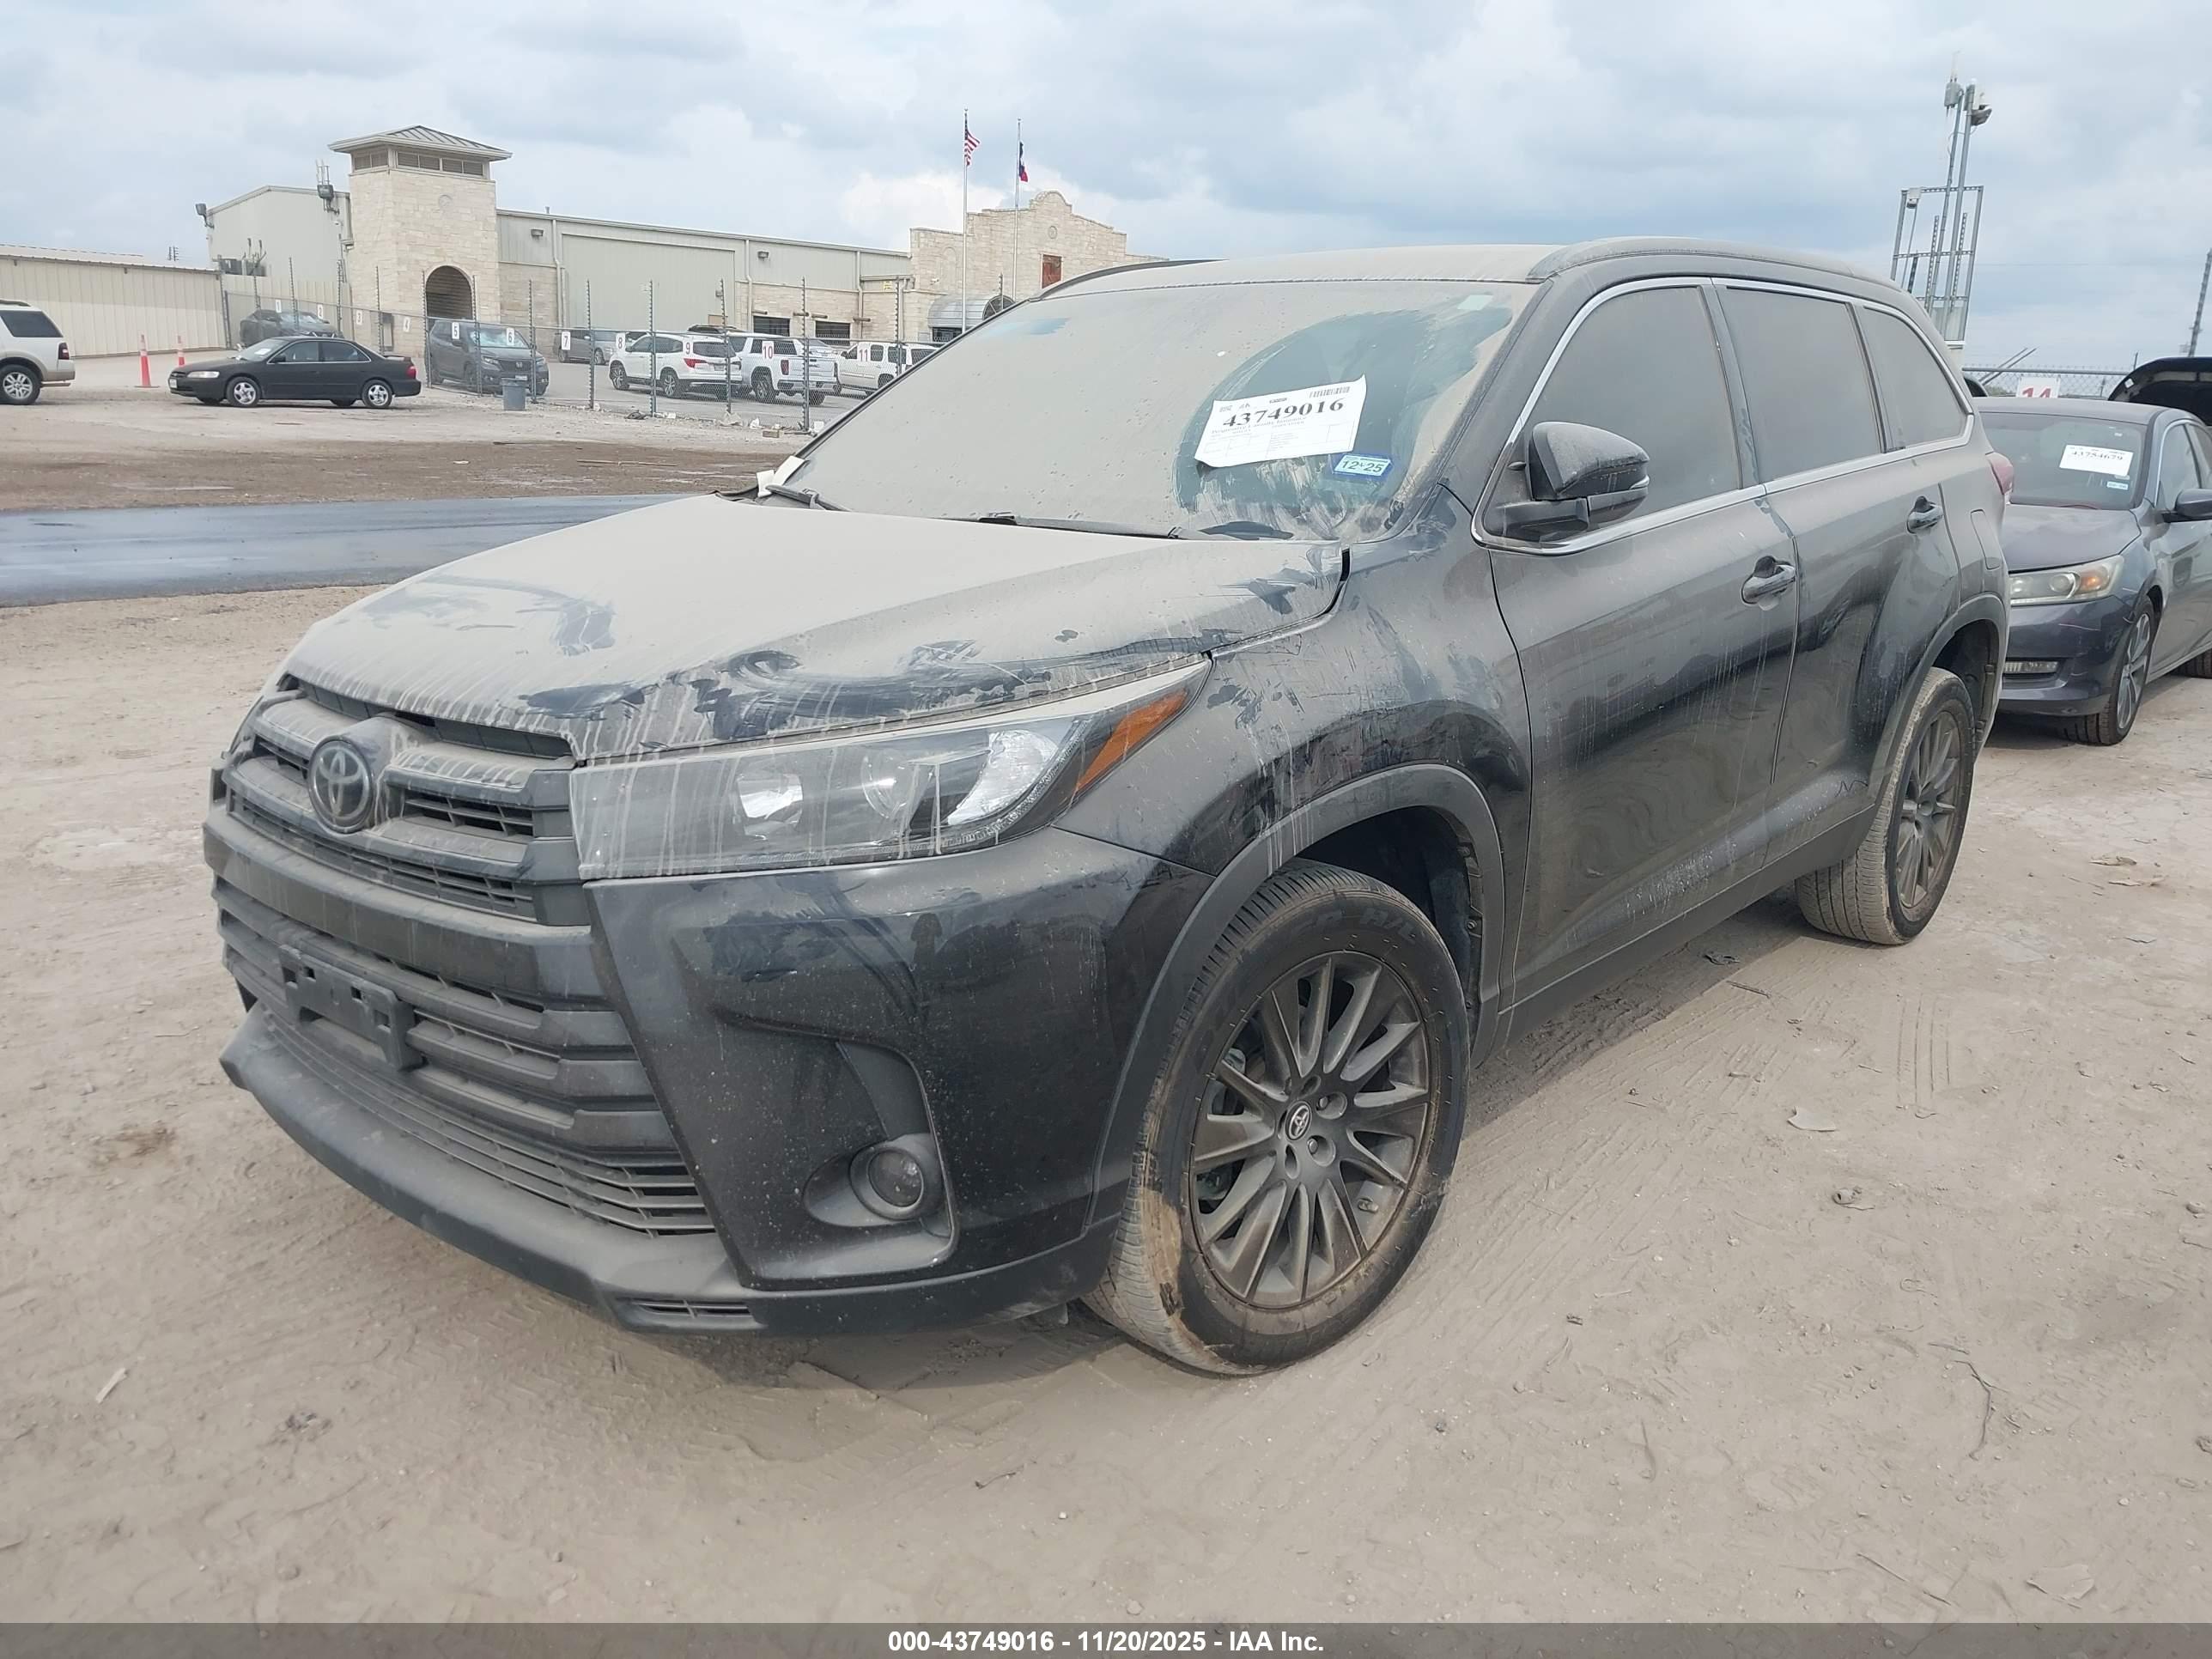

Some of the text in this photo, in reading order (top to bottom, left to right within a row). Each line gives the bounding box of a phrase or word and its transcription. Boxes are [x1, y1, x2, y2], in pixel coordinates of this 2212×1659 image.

[618, 337, 623, 349] 8
[686, 342, 690, 355] 9
[763, 345, 774, 359] 10
[859, 349, 868, 362] 11
[1222, 398, 1346, 427] 43749016
